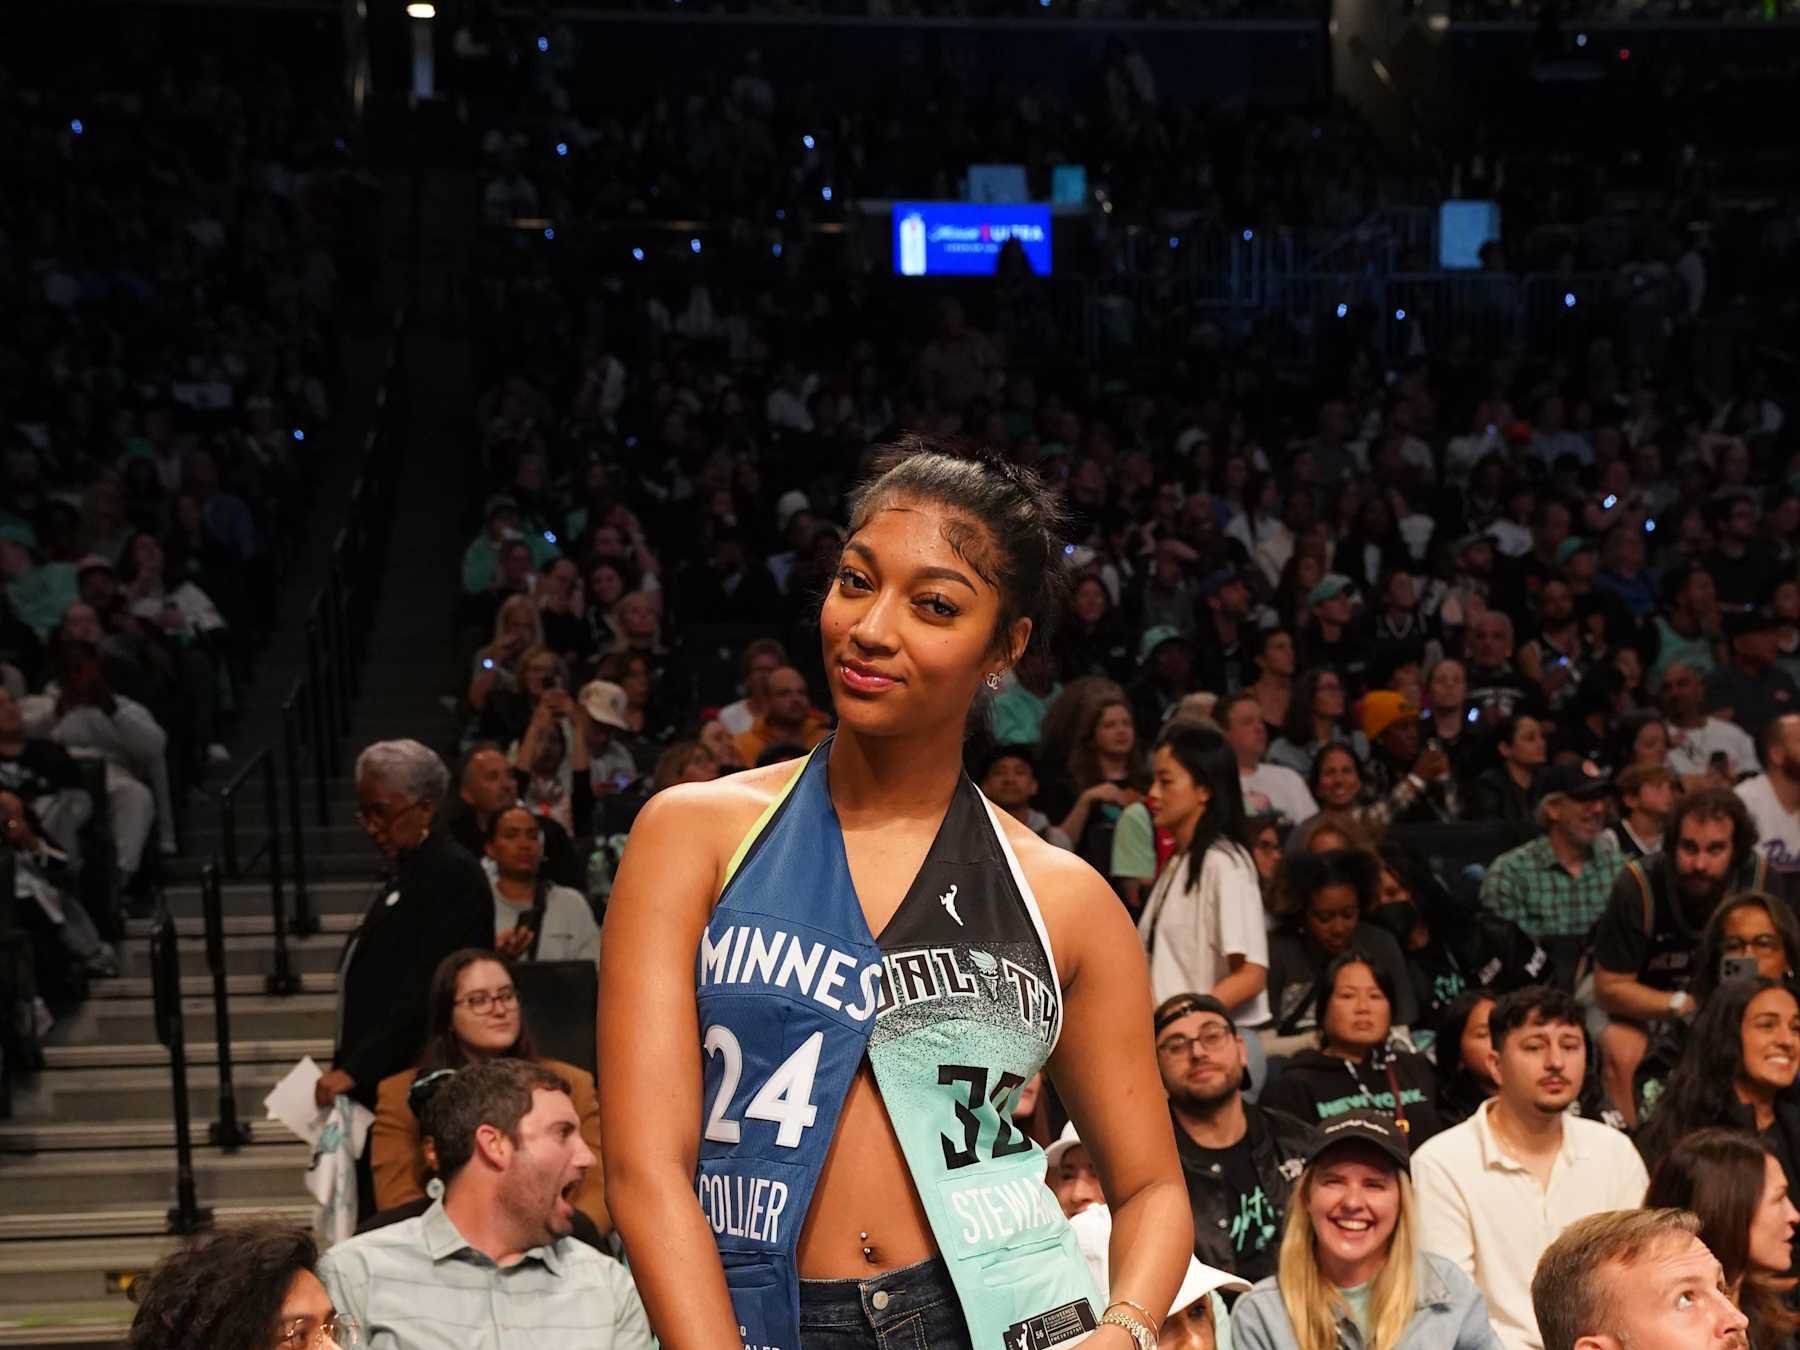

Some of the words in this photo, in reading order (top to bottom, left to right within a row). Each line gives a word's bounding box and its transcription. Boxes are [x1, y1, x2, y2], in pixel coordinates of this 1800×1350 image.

[701, 926, 883, 1022] MINNES
[703, 1024, 824, 1149] 24
[699, 1173, 789, 1244] COLLIER
